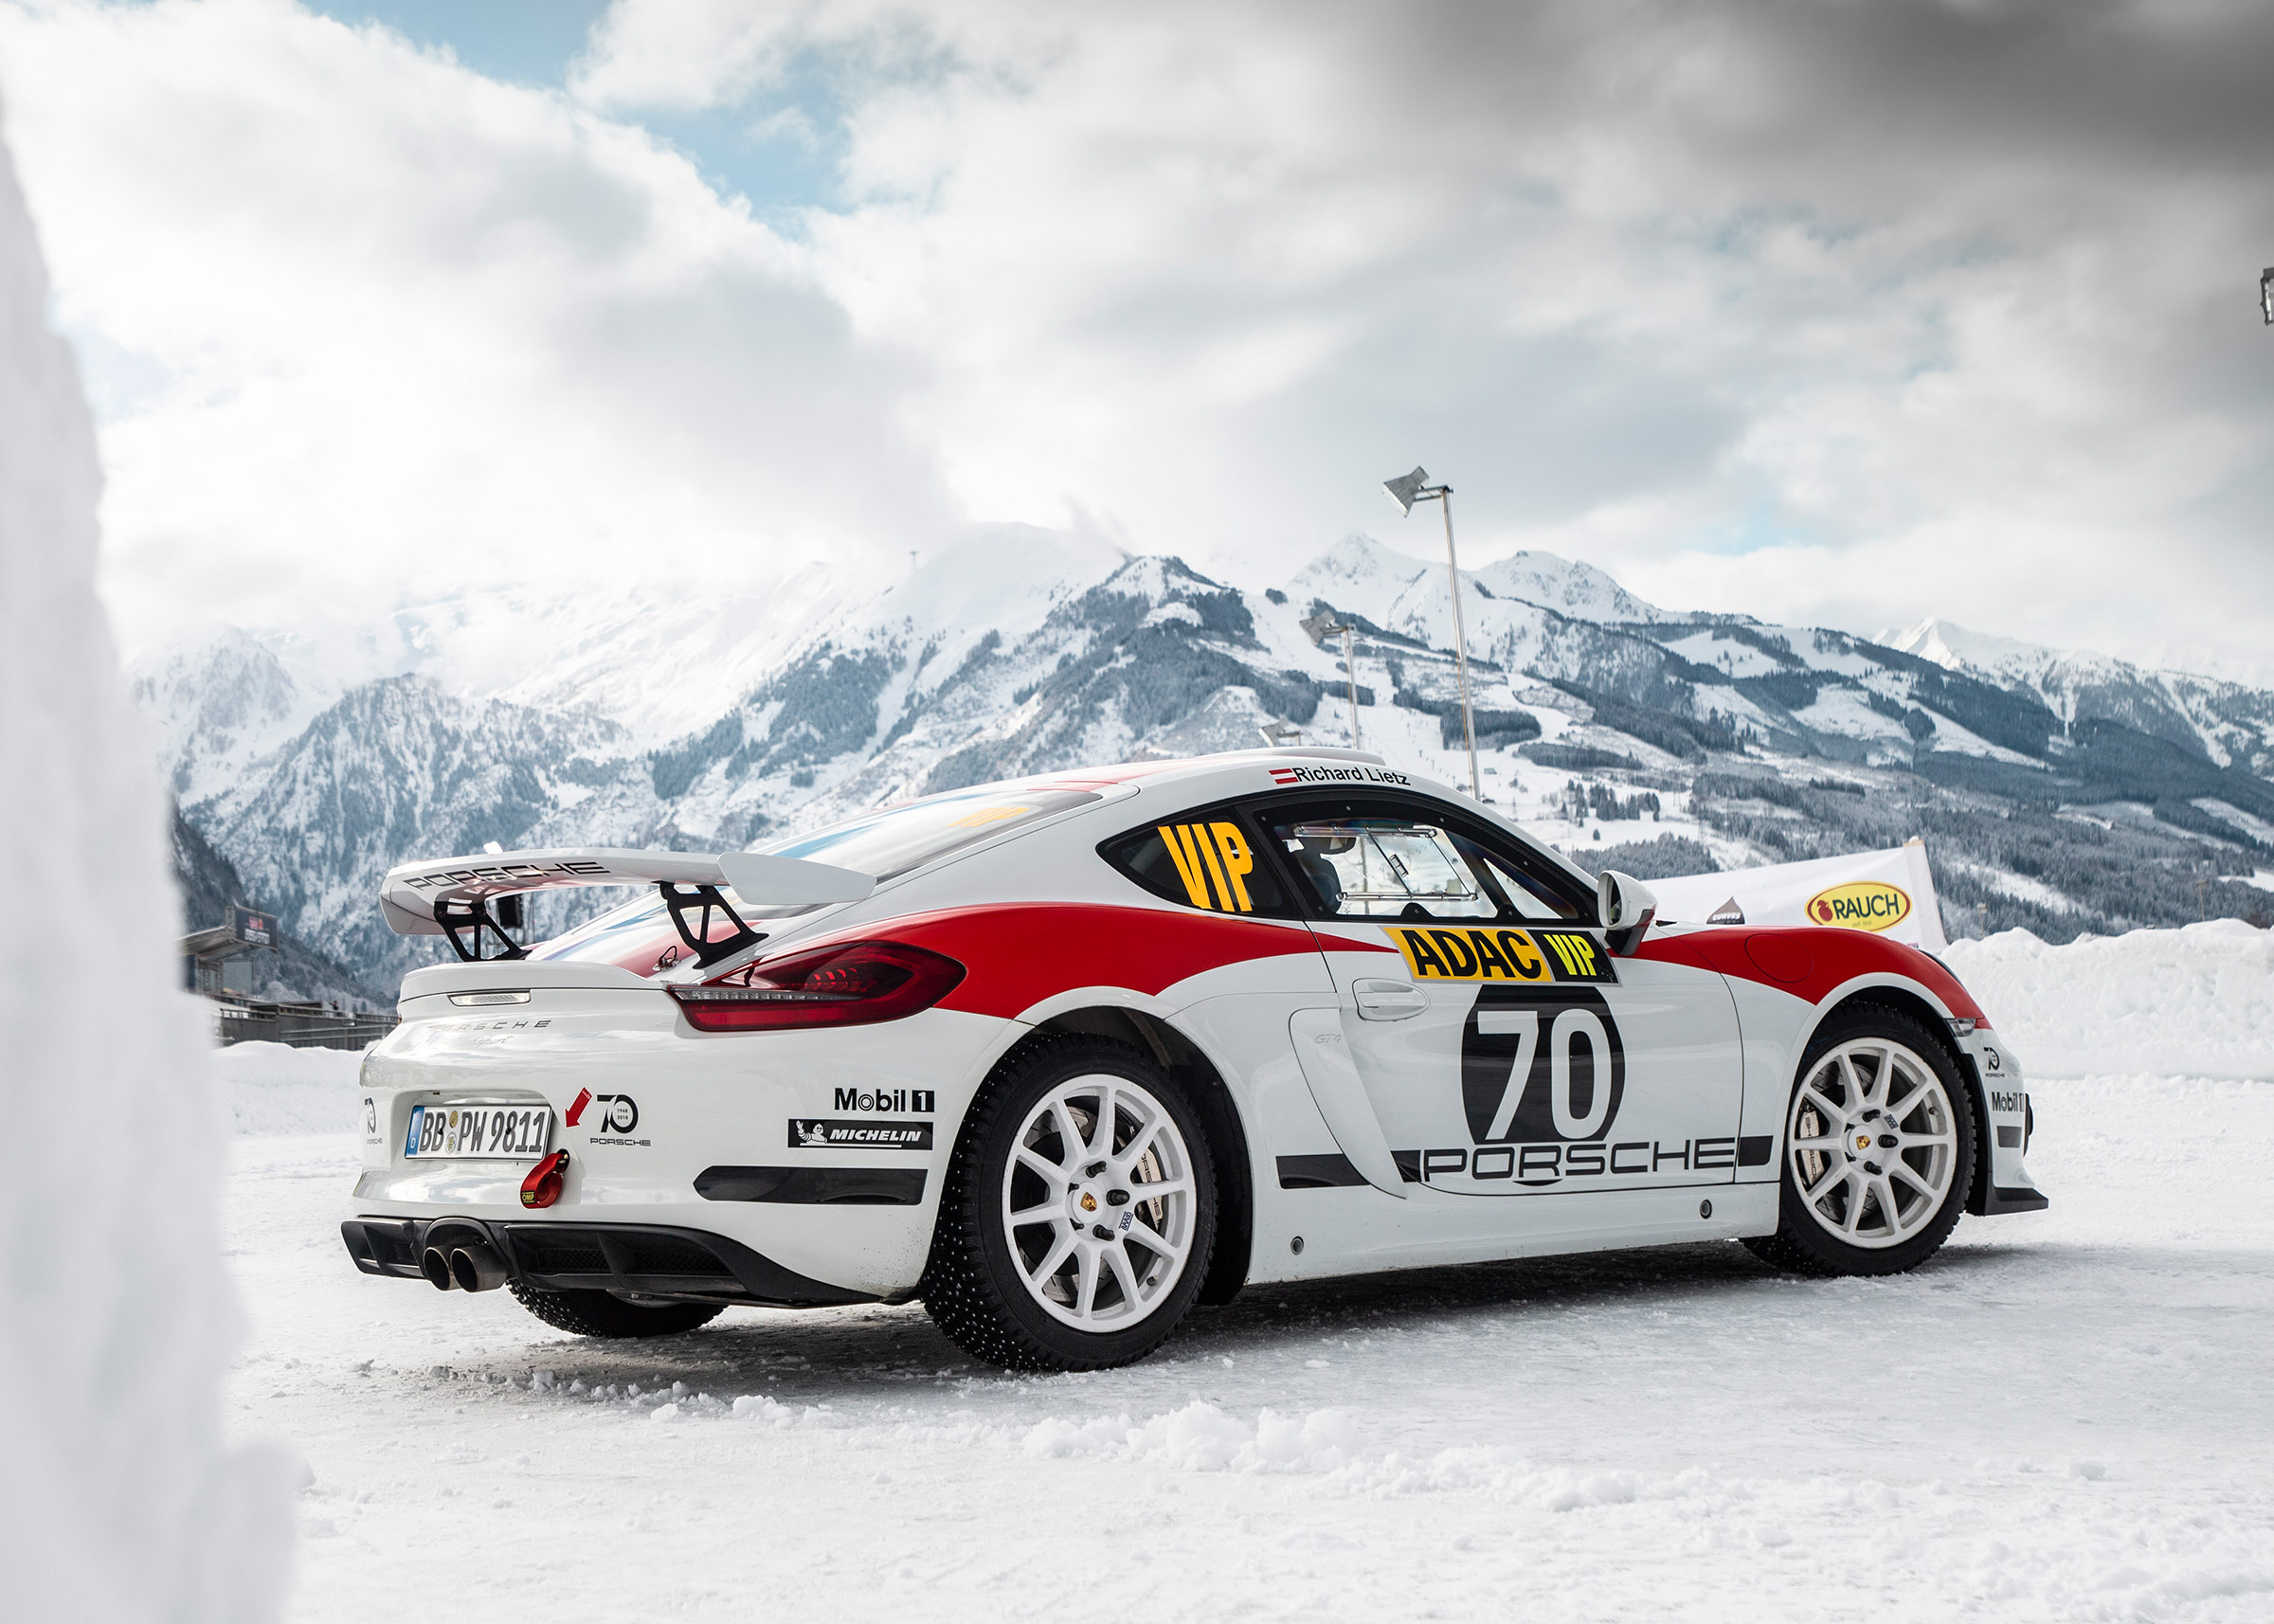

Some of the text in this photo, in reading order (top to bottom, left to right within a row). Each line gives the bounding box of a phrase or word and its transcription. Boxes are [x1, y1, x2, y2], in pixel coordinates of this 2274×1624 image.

[1291, 767, 1412, 786] Richard Lietz
[403, 861, 611, 891] PORSCHE
[1157, 821, 1254, 912] VIP
[1832, 893, 1901, 920] RAUCH
[1399, 929, 1597, 980] ADAC VIP
[428, 1020, 552, 1033] RSCHE
[1314, 1033, 1342, 1044] GT4
[1477, 1008, 1613, 1141] 70
[834, 1087, 907, 1112] Mobil
[1991, 1092, 2018, 1112] Mobil
[596, 1093, 640, 1134] 70
[409, 1138, 417, 1149] D
[419, 1111, 546, 1153] BB PW 9811
[590, 1138, 652, 1146] PORSCHE
[829, 1128, 923, 1143] MICHELIN
[1424, 1137, 1737, 1182] PORSCHE
[522, 1193, 534, 1201] OMP
